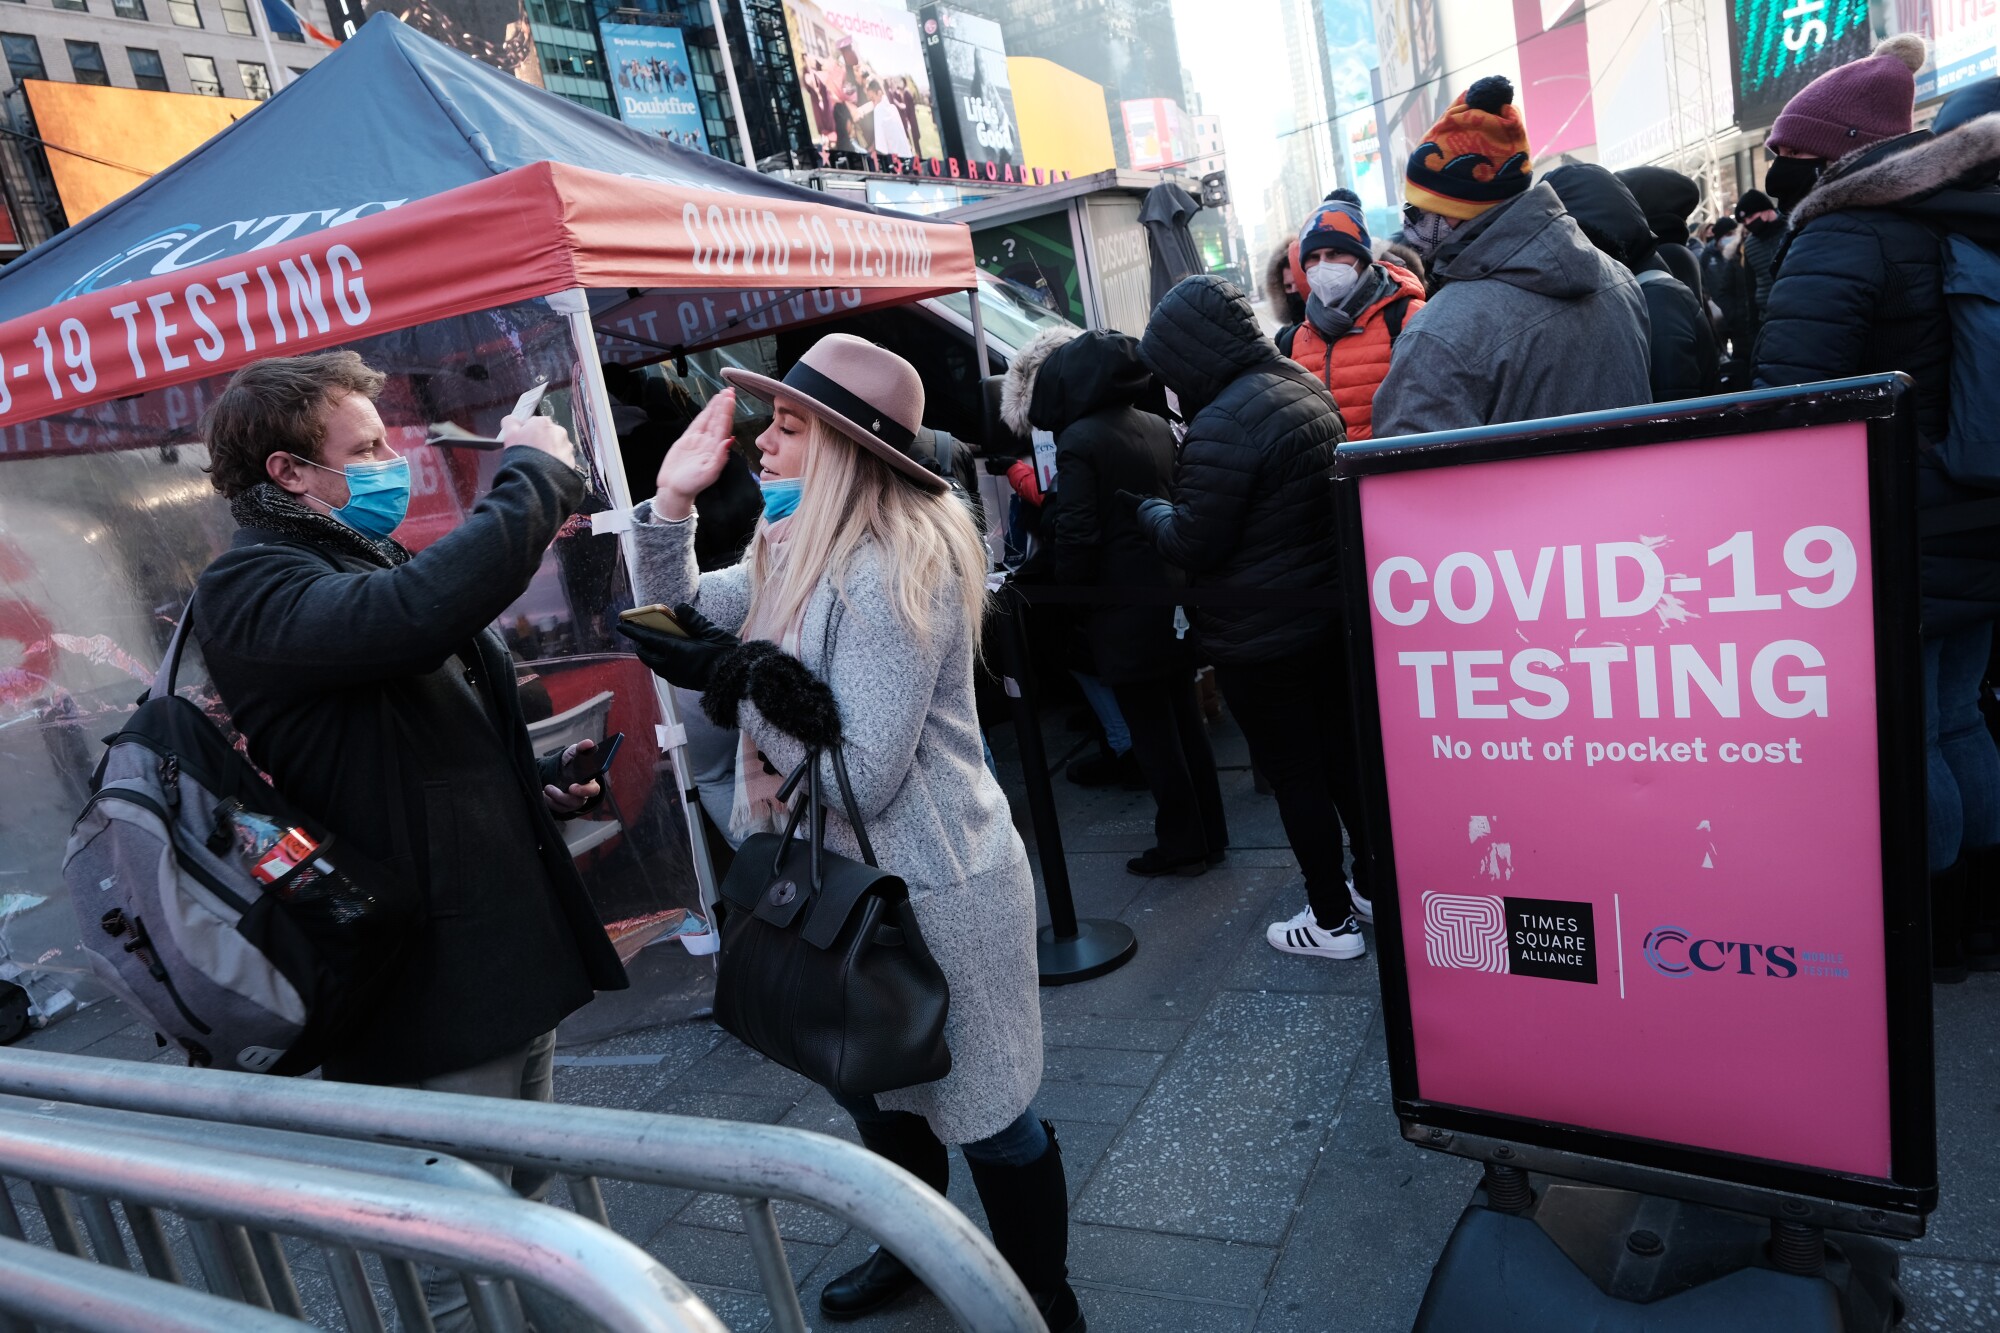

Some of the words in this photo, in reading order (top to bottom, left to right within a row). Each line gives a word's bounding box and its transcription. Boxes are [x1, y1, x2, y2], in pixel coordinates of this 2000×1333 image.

[826, 10, 894, 41] academic
[927, 34, 940, 46] LG
[624, 97, 697, 115] Doubtfire
[963, 96, 999, 125] Life's
[683, 202, 834, 277] COVID-19
[836, 217, 932, 278] TESTING
[1097, 229, 1145, 273] DISCOVER
[110, 244, 372, 379] TESTING
[1372, 525, 1857, 626] COVID-19
[1398, 639, 1829, 720] TESTING
[1431, 735, 1472, 760] No
[1481, 739, 1533, 761] out
[1543, 736, 1574, 761] of
[1586, 737, 1708, 766] pocket
[1718, 738, 1803, 763] cost
[1519, 914, 1578, 932] TIMES
[1515, 931, 1586, 951] SQUARE
[1521, 949, 1583, 966] ALLIANCE
[1802, 950, 1844, 964] MOBILE
[1802, 964, 1849, 978] TESTING
